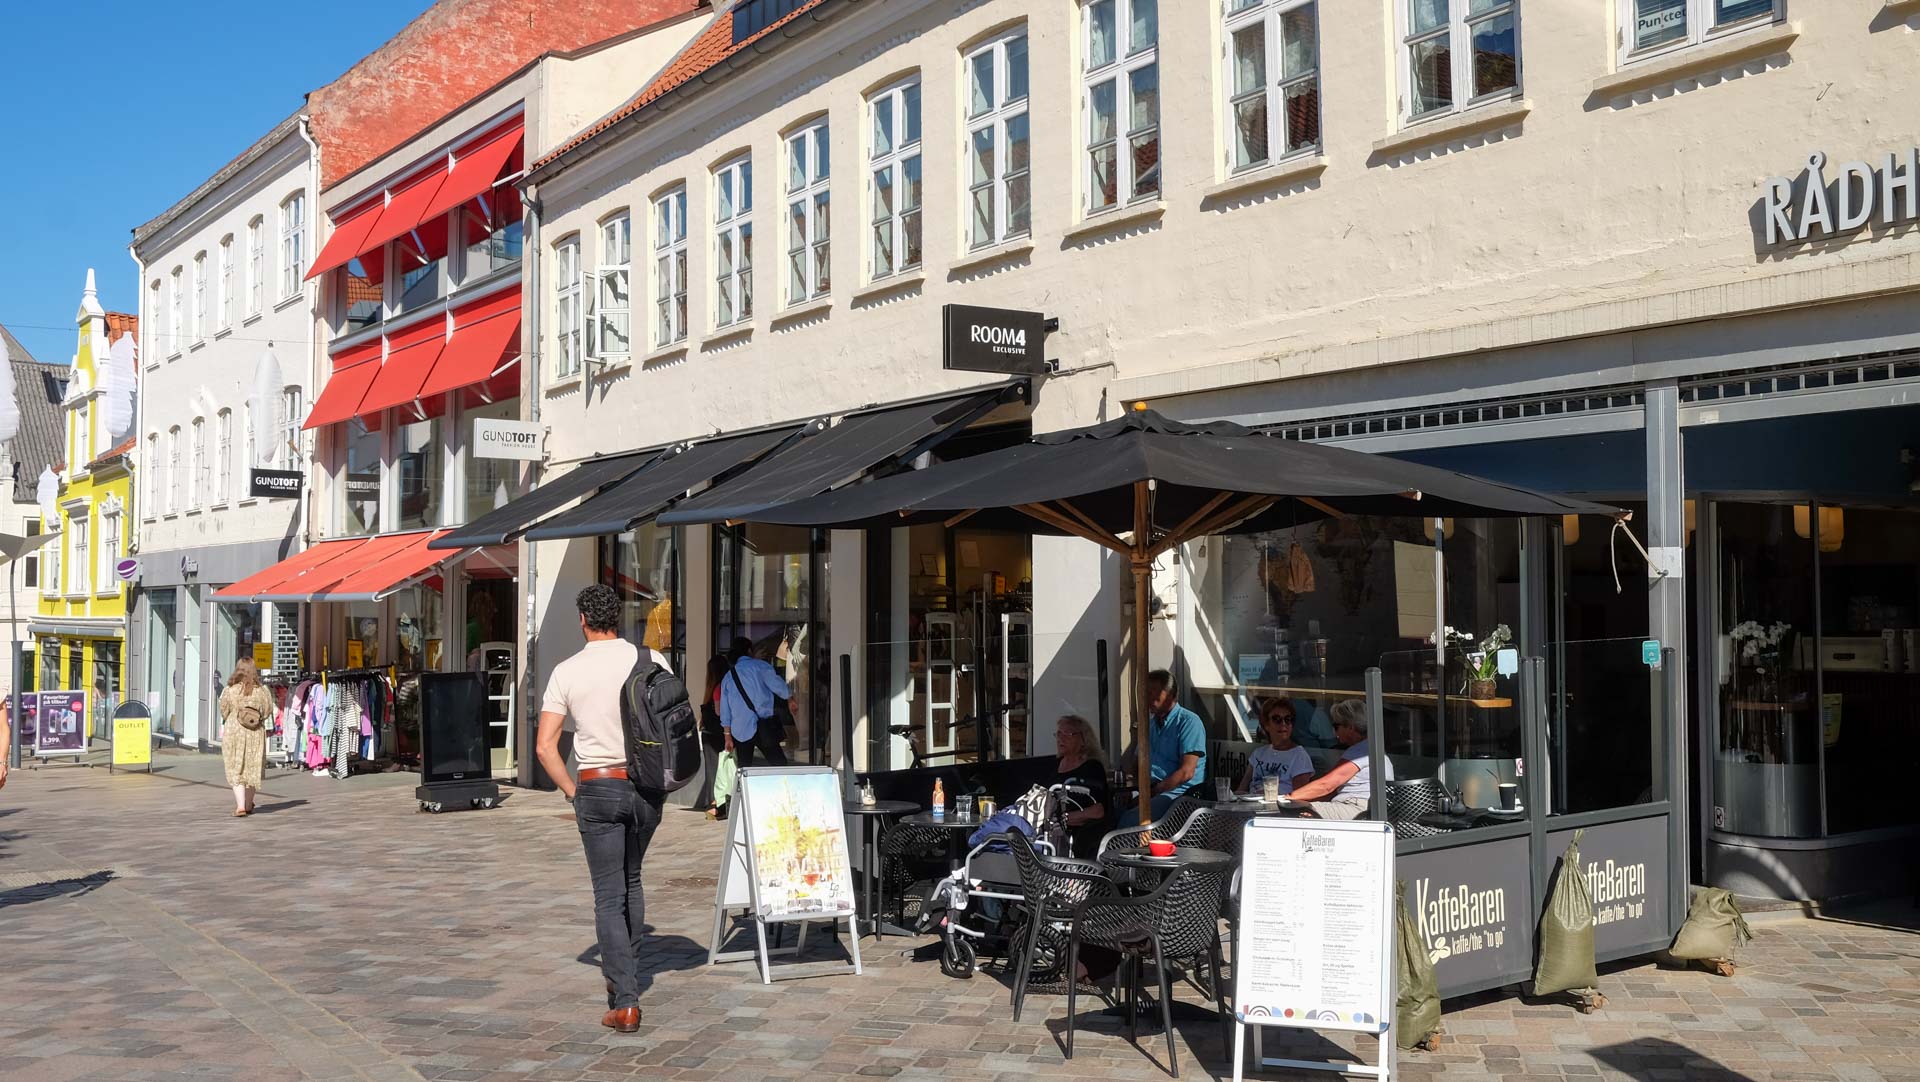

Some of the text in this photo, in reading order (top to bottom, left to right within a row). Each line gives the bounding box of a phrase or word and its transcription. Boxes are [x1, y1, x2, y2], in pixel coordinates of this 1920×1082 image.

[1764, 149, 1919, 246] RÅDH
[971, 324, 1026, 346] ROOM4
[992, 346, 1026, 355] EXCLUSIVE
[482, 430, 537, 444] GUNDTOFT
[255, 476, 299, 487] GUNDTOFT
[1302, 831, 1336, 849] KaffeBaren
[1577, 852, 1645, 904] ffeBaren
[1416, 878, 1505, 950] KaffeBaren
[1598, 904, 1625, 925] kaffe/the
[1452, 932, 1483, 956] kaffe/the
